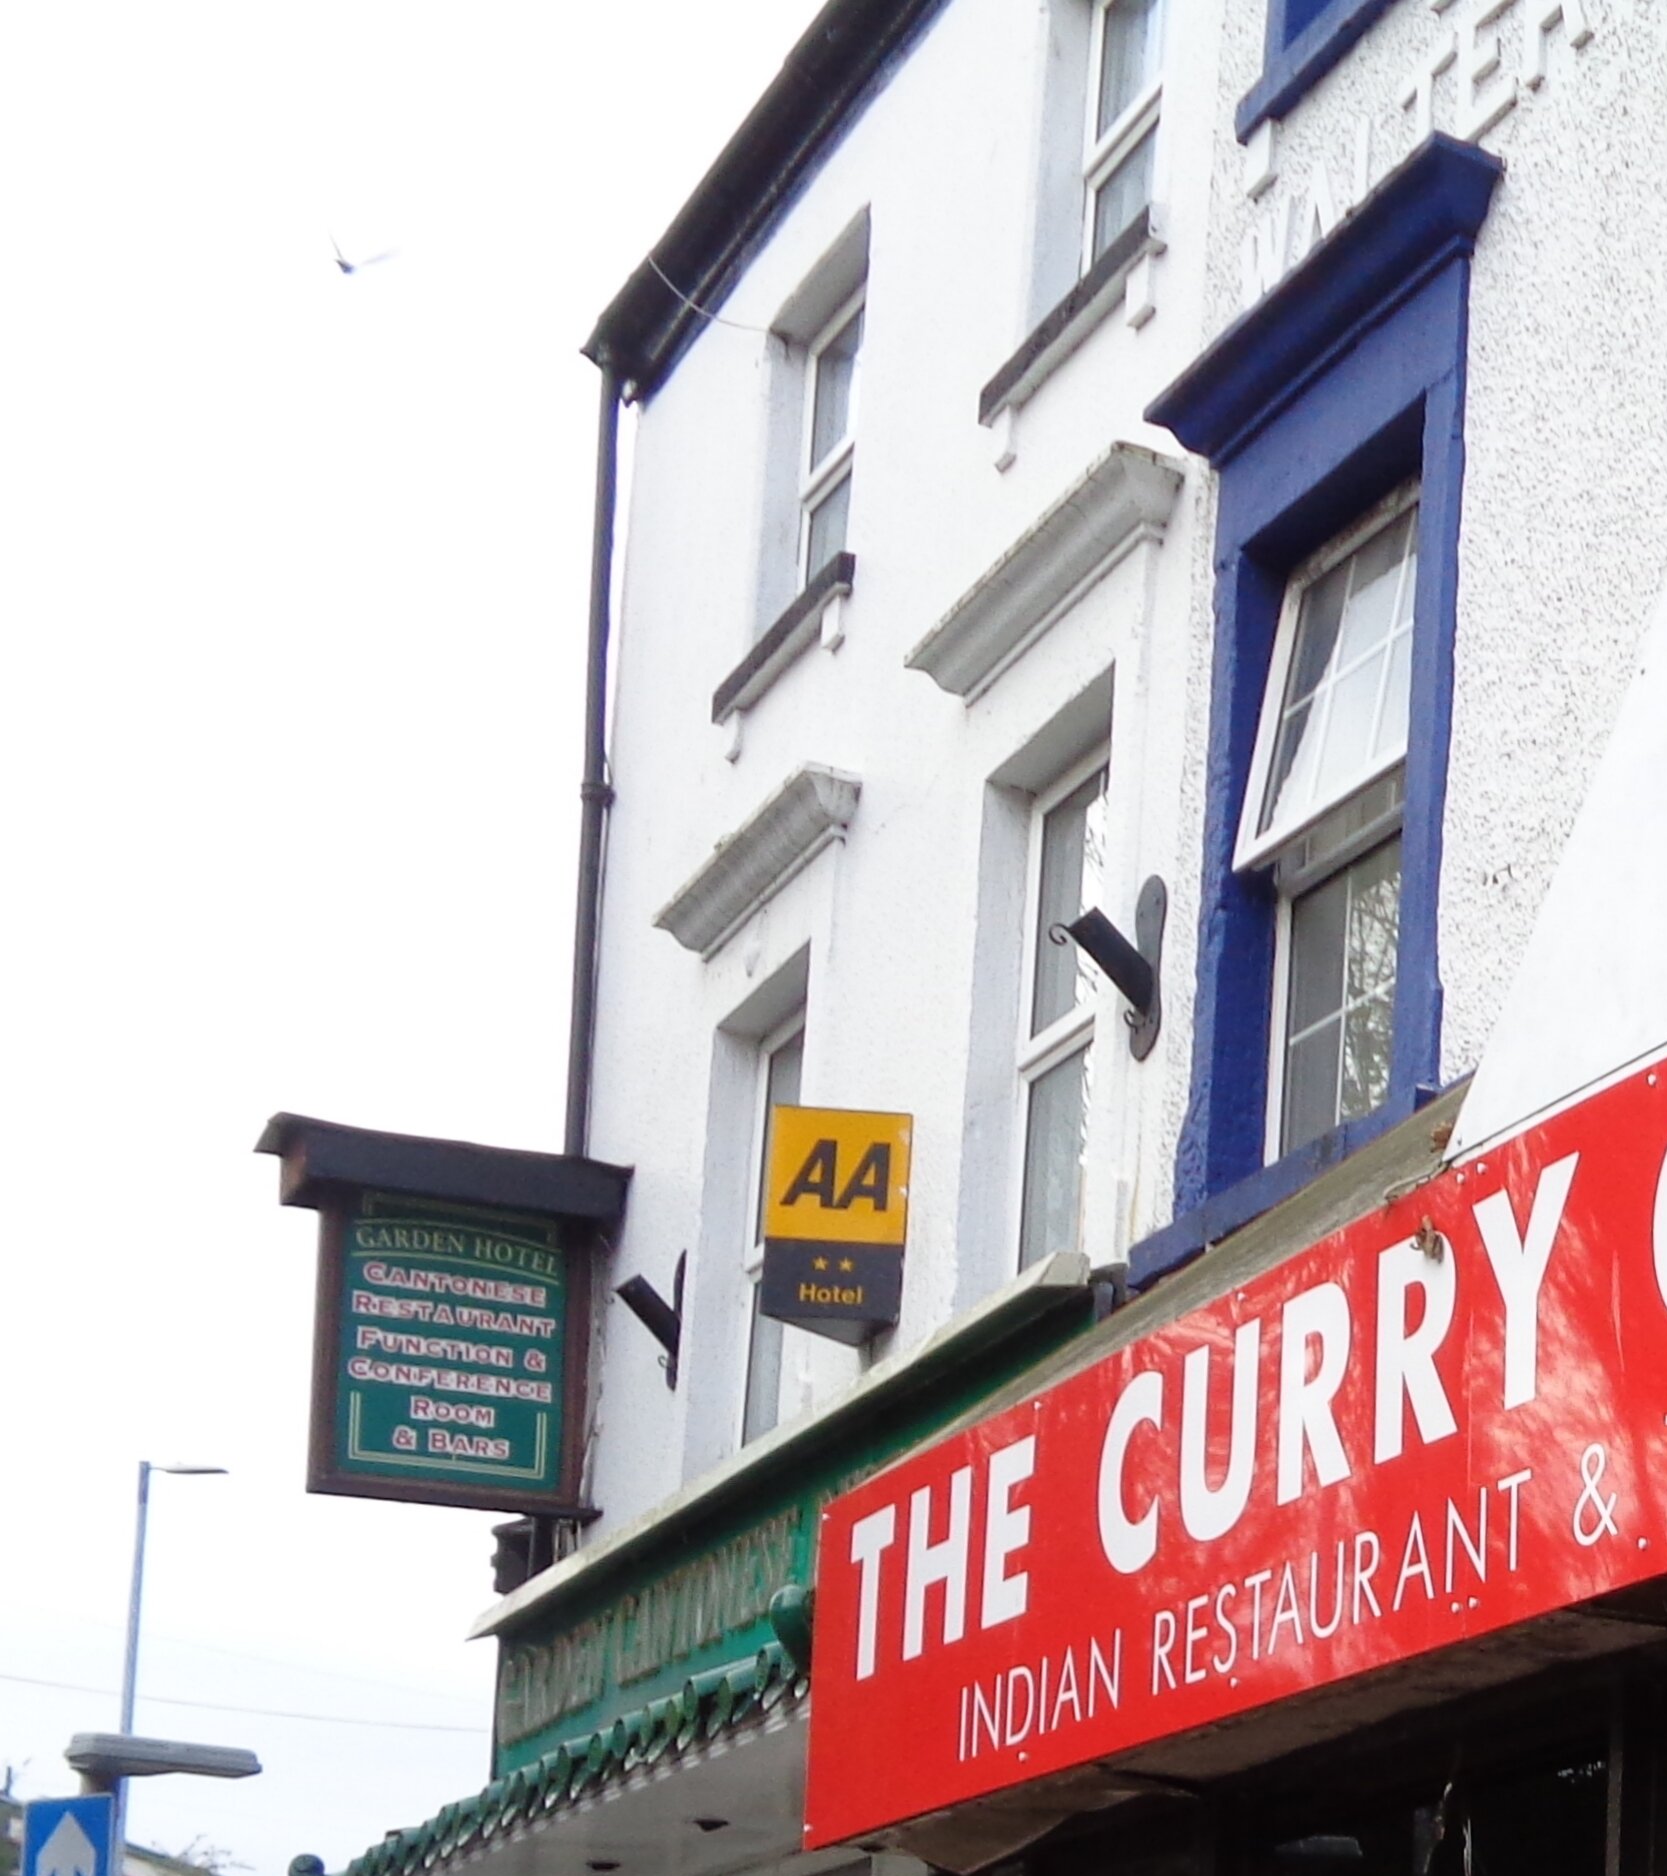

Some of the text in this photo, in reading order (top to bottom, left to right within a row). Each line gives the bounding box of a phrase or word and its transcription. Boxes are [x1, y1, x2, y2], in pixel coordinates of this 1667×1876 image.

[779, 1138, 892, 1212] AA
[355, 1226, 558, 1276] GARDEN HOTEL
[363, 1261, 547, 1308] CANTONESE
[799, 1283, 864, 1305] Hotel
[352, 1290, 556, 1338] RESTAURANT
[357, 1326, 547, 1372] FUNCTION &
[348, 1356, 552, 1402] CONFERENCE
[410, 1396, 495, 1428] ROOM
[850, 1434, 1037, 1681] THE
[1098, 1151, 1599, 1574] CURRY
[393, 1425, 510, 1459] & BARS
[957, 1628, 1121, 1763] INDIAN
[1152, 1468, 1532, 1696] RESTAURANT
[1572, 1443, 1619, 1547] &
